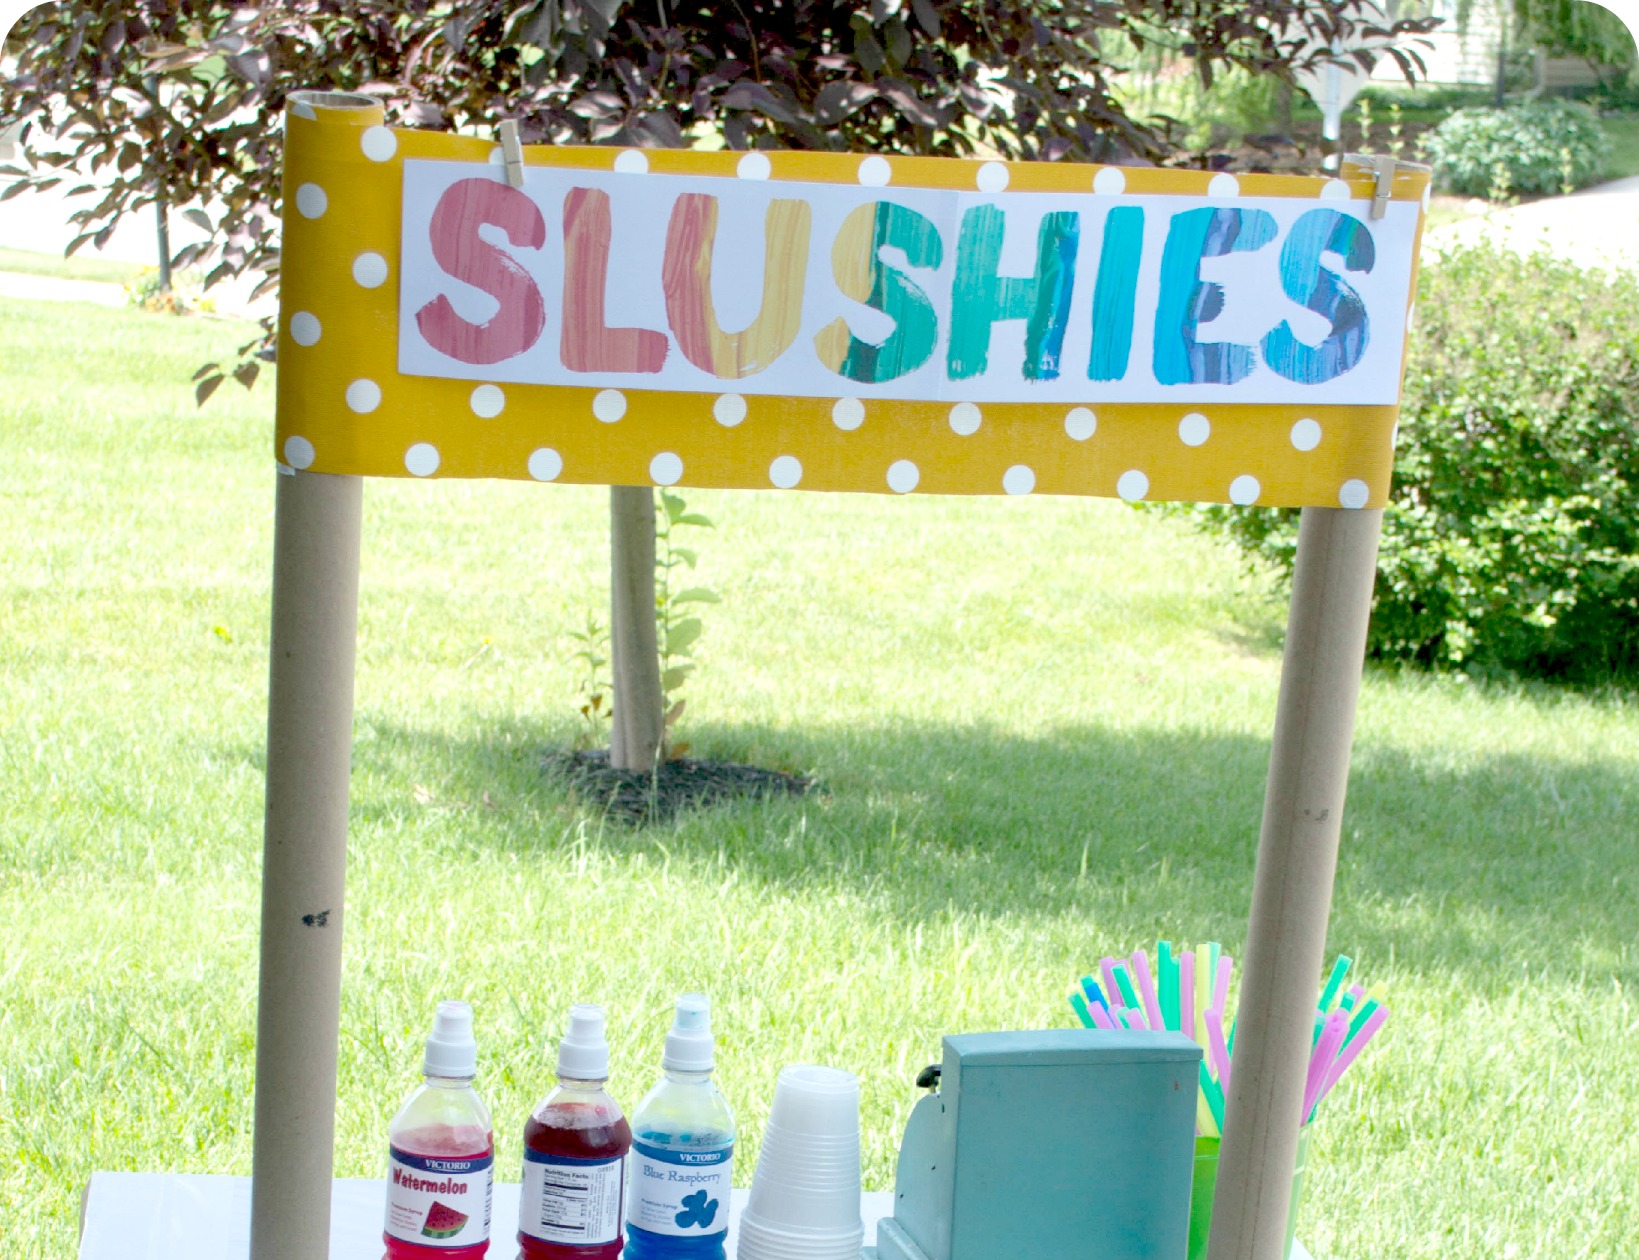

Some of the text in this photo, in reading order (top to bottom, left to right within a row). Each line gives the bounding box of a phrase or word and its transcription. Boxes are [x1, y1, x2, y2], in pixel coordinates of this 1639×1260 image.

[415, 176, 1376, 385] SLUSHIES
[425, 1159, 471, 1170] VICTORIO
[680, 1153, 721, 1162] VICTORIO
[392, 1166, 468, 1195] Watermelon
[544, 1168, 571, 1178] Nutrition
[643, 1164, 665, 1180] Blue
[668, 1170, 721, 1187] Raspberry
